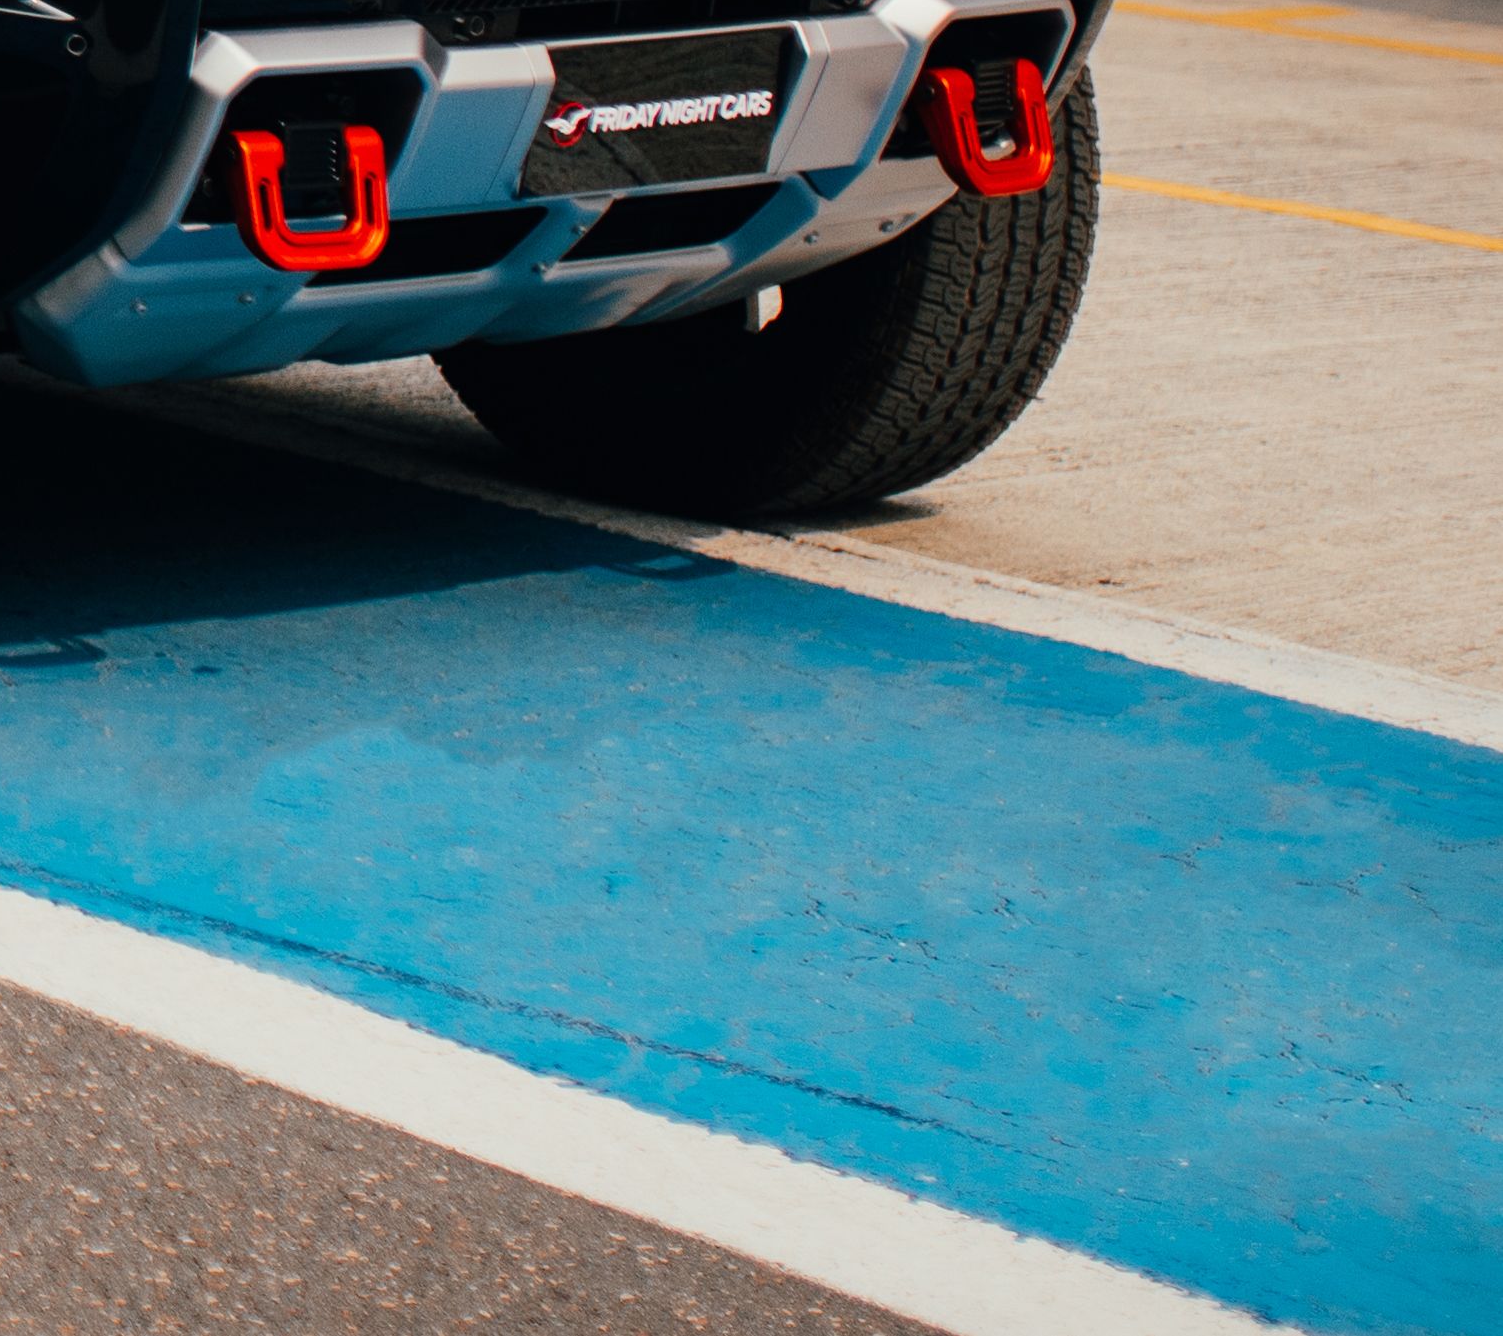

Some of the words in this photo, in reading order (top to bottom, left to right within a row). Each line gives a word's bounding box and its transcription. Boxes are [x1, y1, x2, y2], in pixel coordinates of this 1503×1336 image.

[590, 101, 661, 134] FRIDAY
[658, 96, 722, 127] NIGHT
[719, 90, 773, 121] CARS
